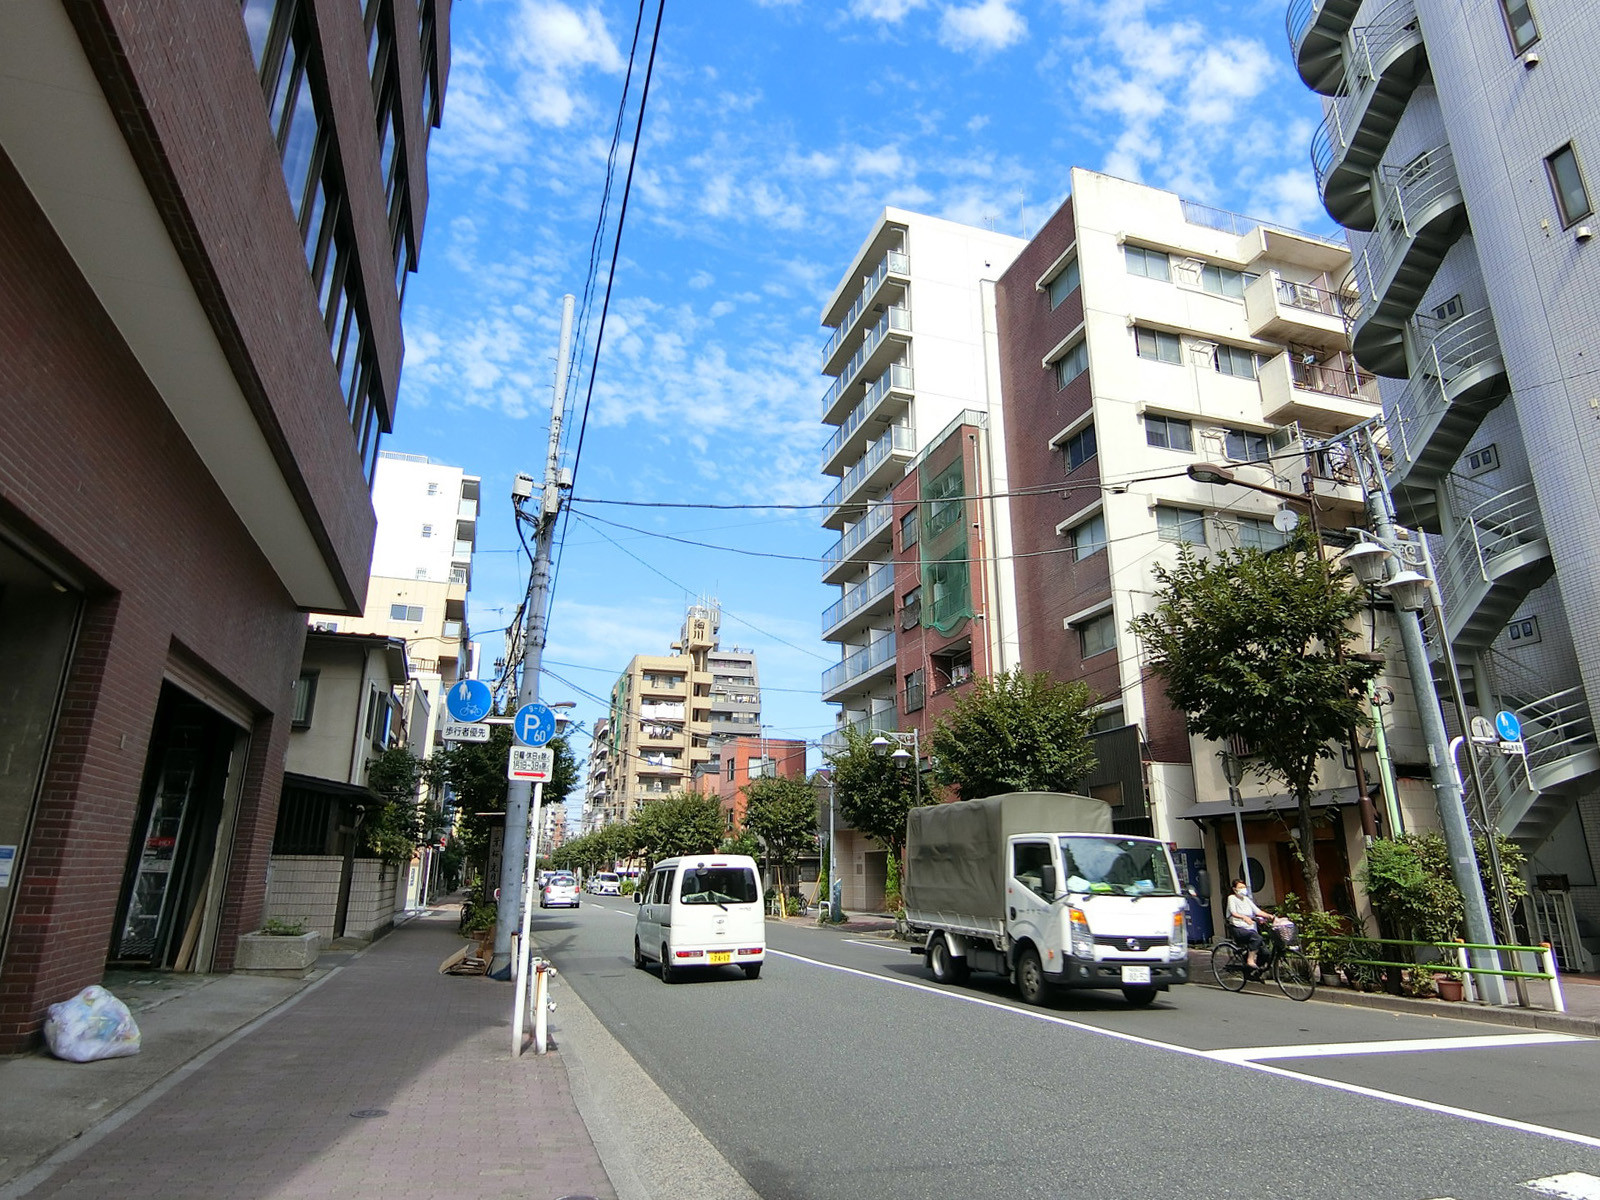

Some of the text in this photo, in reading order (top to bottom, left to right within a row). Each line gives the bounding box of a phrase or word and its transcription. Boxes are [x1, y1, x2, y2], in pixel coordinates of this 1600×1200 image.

[446, 726, 486, 738] 歩行者優先
[523, 714, 540, 740] P
